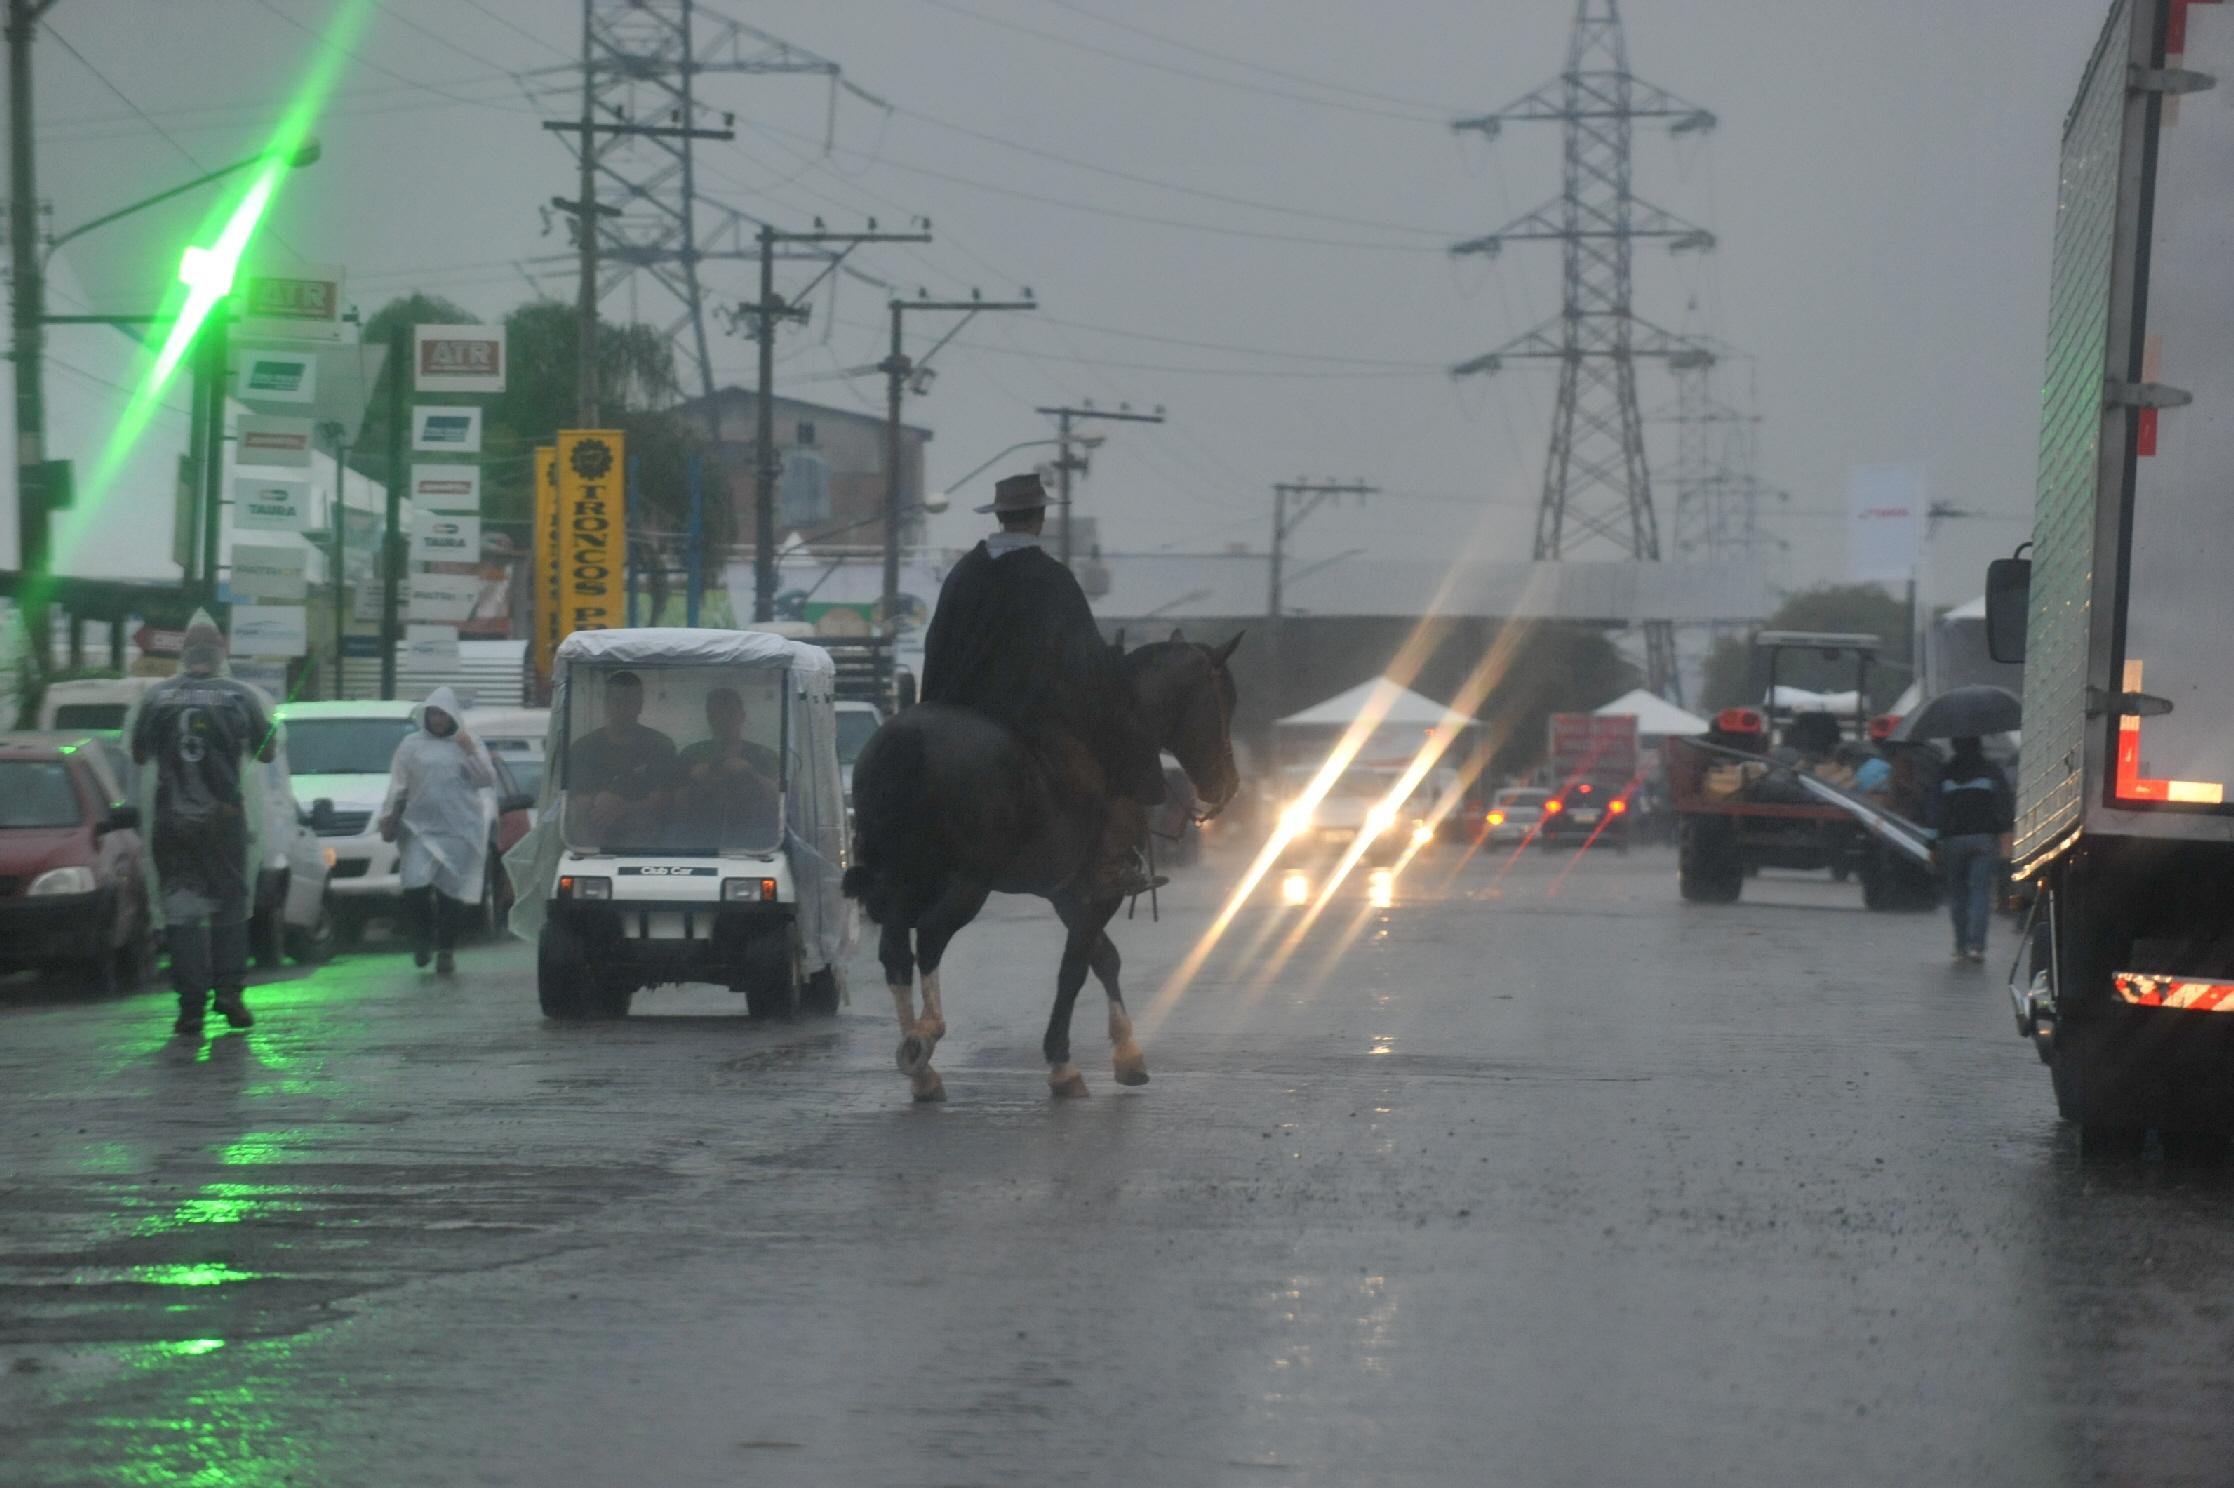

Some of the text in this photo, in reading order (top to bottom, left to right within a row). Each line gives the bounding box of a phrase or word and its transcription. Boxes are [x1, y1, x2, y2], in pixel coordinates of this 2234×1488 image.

[431, 341, 490, 366] ATR
[574, 485, 608, 595] TRONCOS
[413, 590, 475, 602] PATRIT
